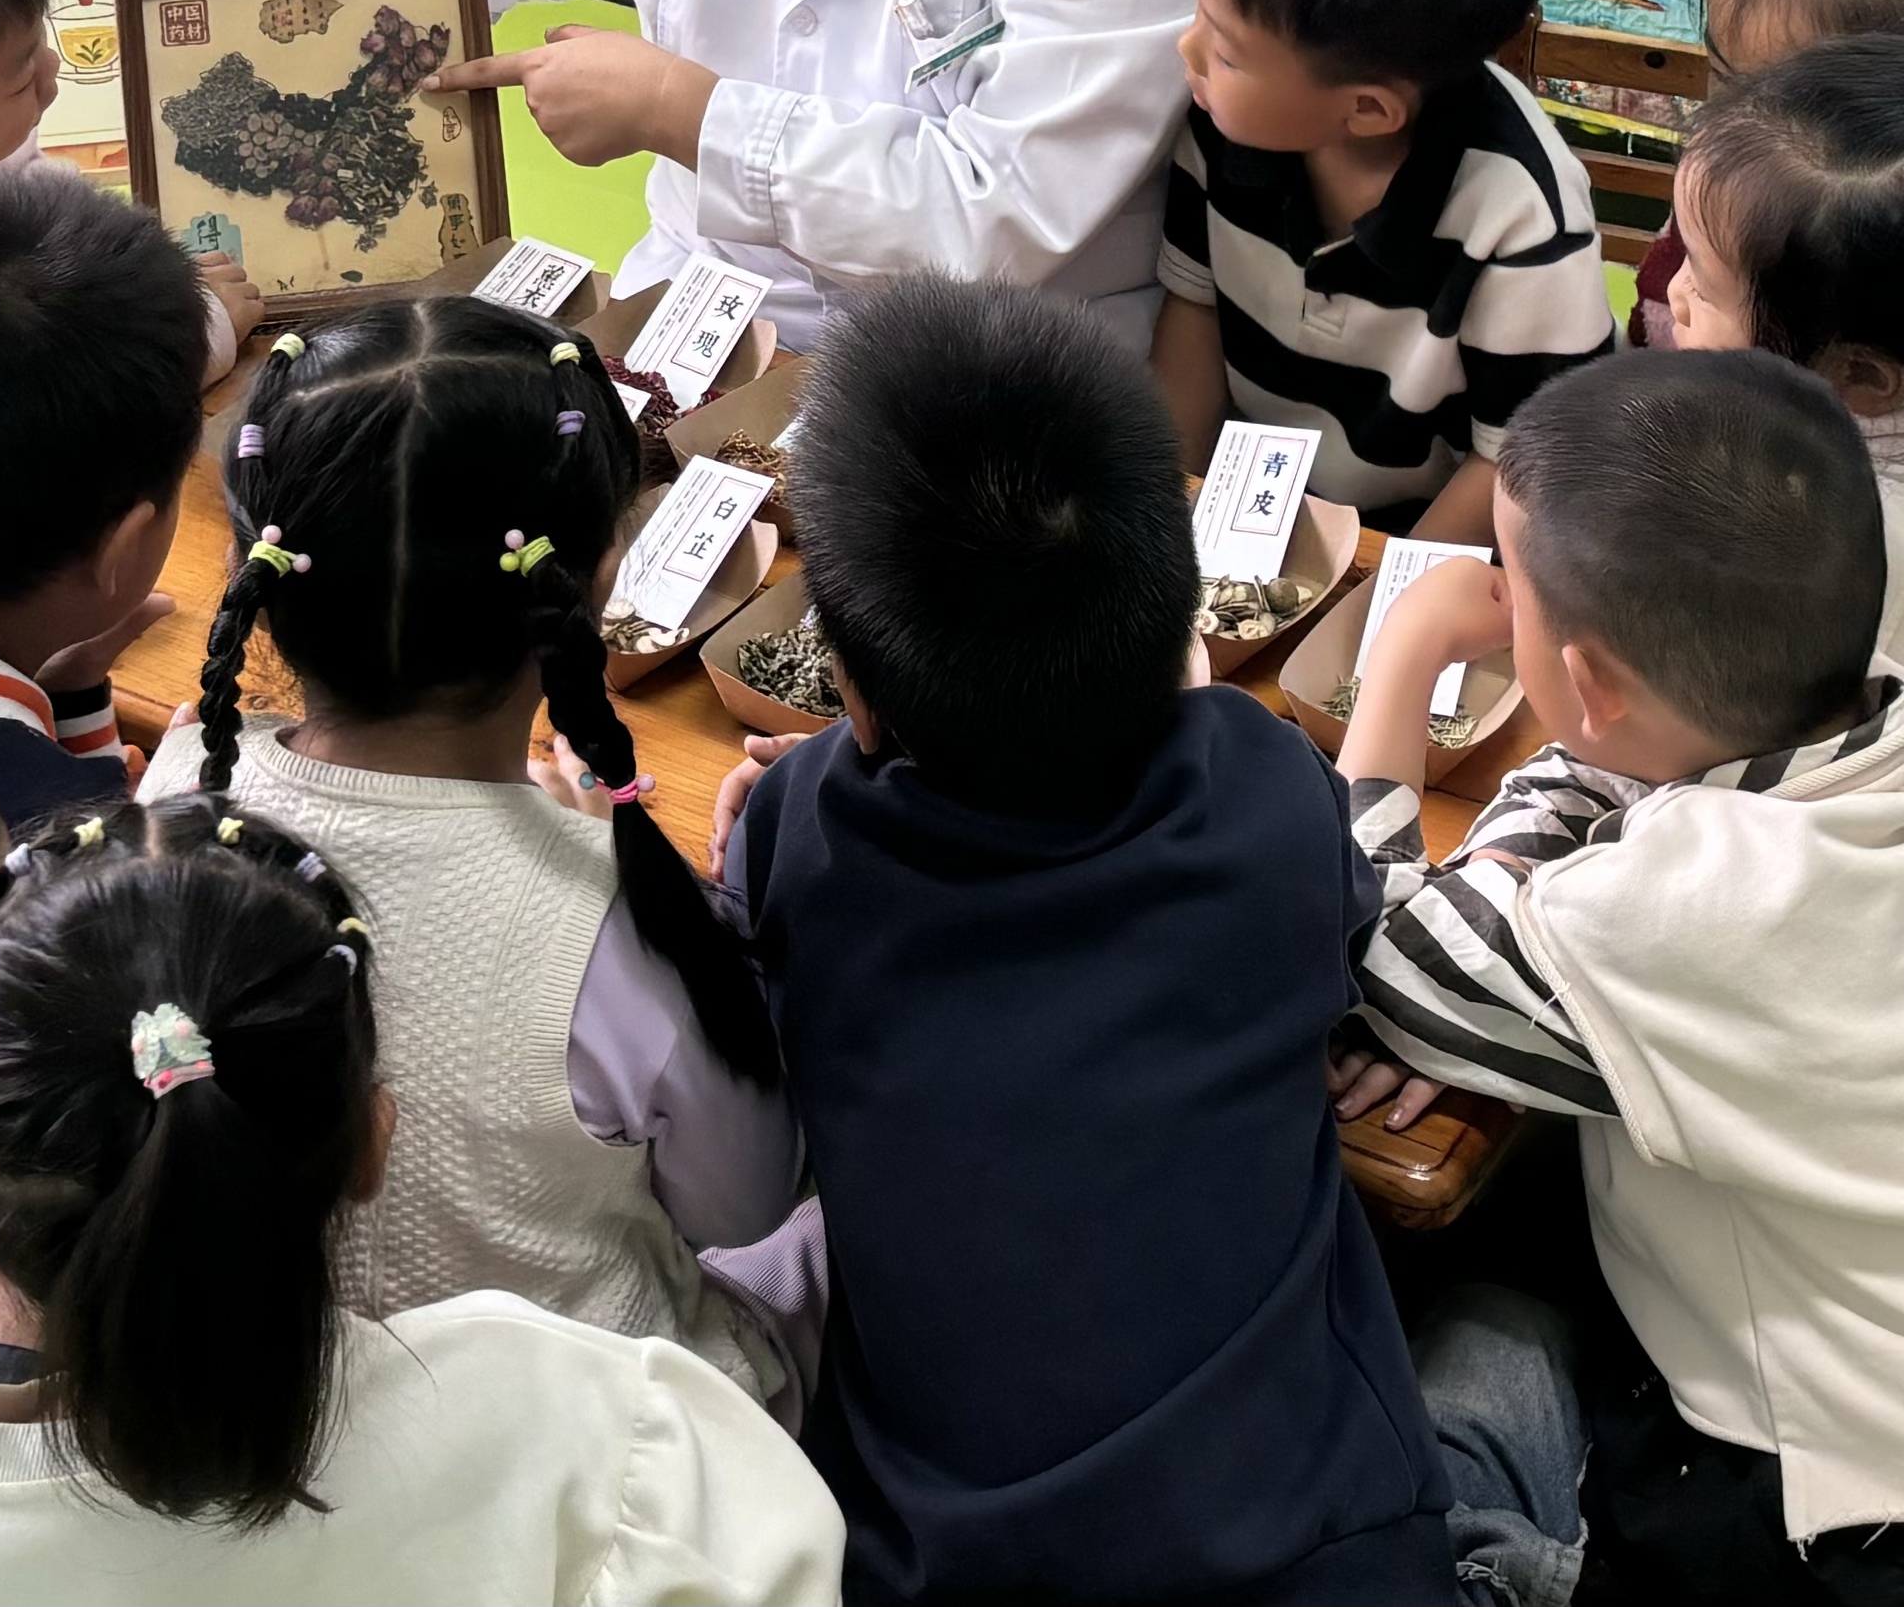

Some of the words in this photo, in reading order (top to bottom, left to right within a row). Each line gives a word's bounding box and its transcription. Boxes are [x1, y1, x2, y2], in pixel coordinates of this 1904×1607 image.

[692, 295, 744, 358] 玫瑰
[1245, 451, 1288, 516] 青皮
[683, 498, 737, 559] 白芷
